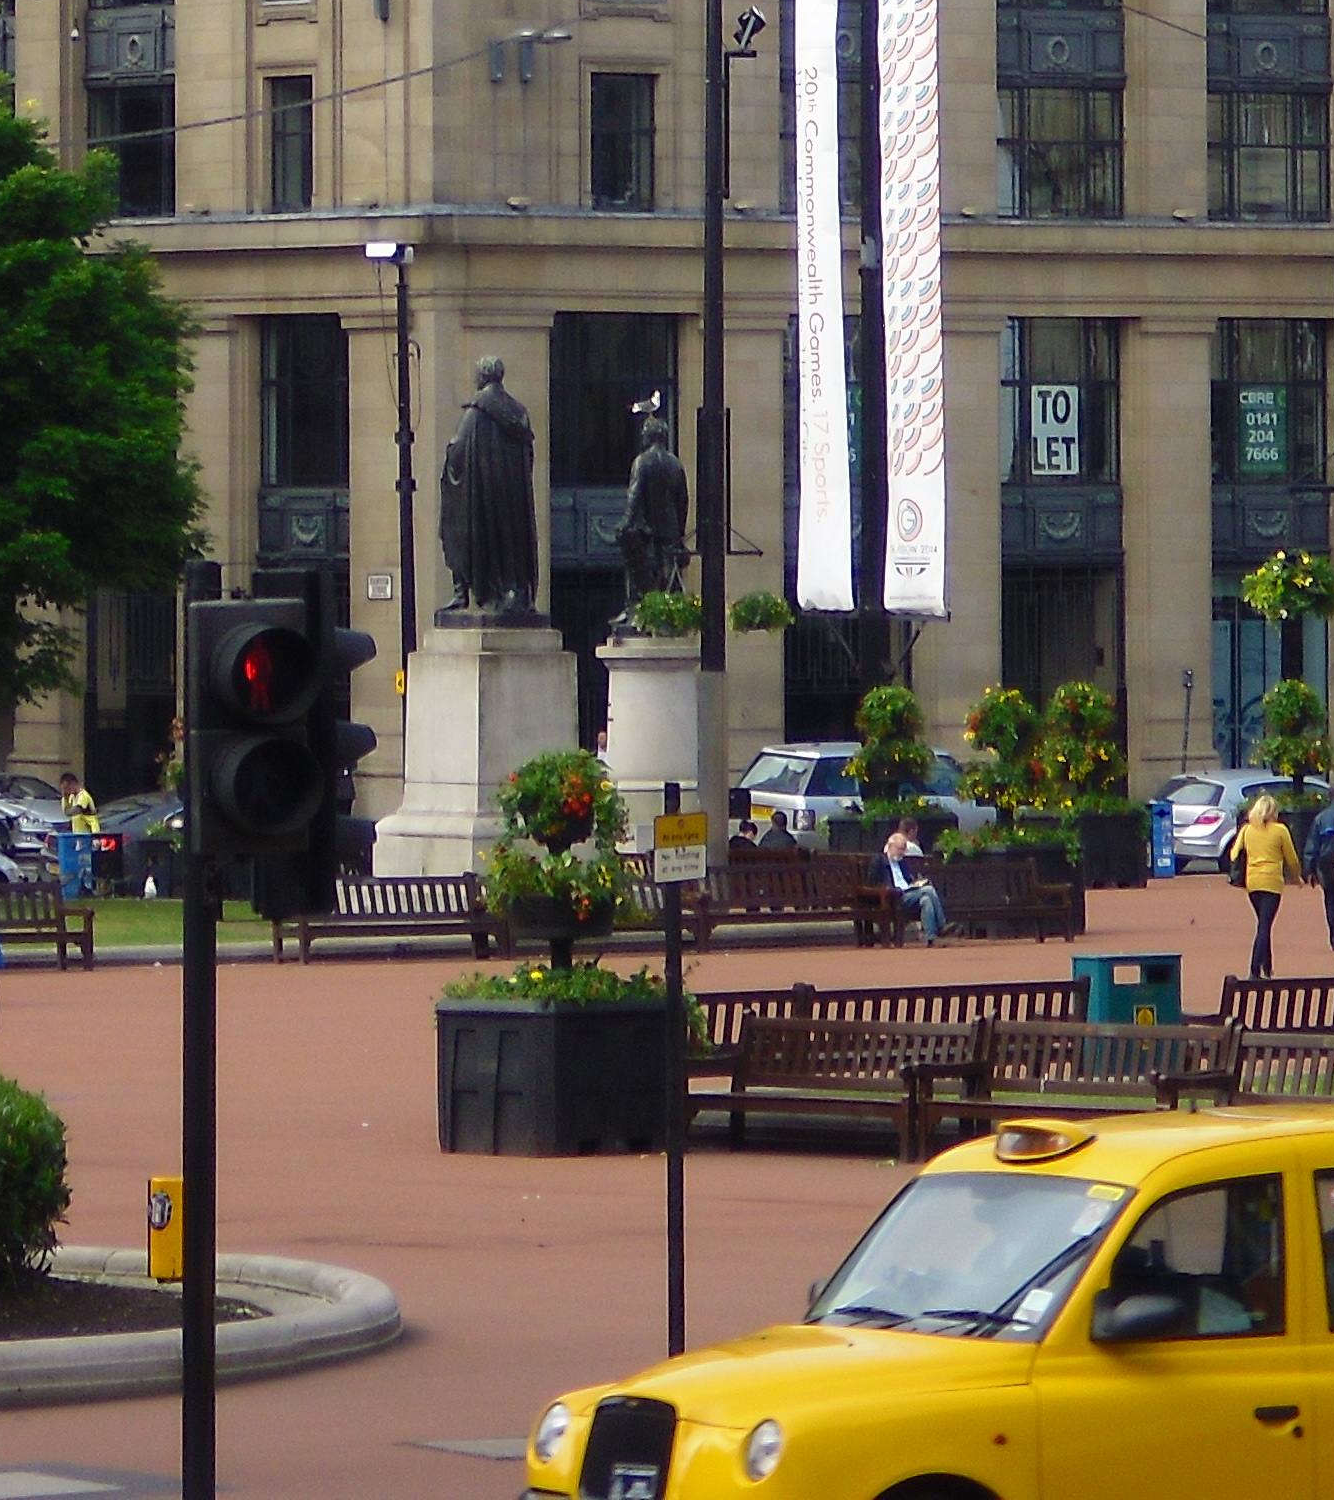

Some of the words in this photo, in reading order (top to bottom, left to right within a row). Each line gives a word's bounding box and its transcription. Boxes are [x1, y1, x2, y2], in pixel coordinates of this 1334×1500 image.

[803, 119, 820, 306] Commonwealth
[1037, 390, 1071, 424] TO
[1246, 413, 1278, 426] 0141
[1248, 430, 1274, 443] 204
[1033, 436, 1076, 471] LET
[1245, 447, 1279, 461] 7666
